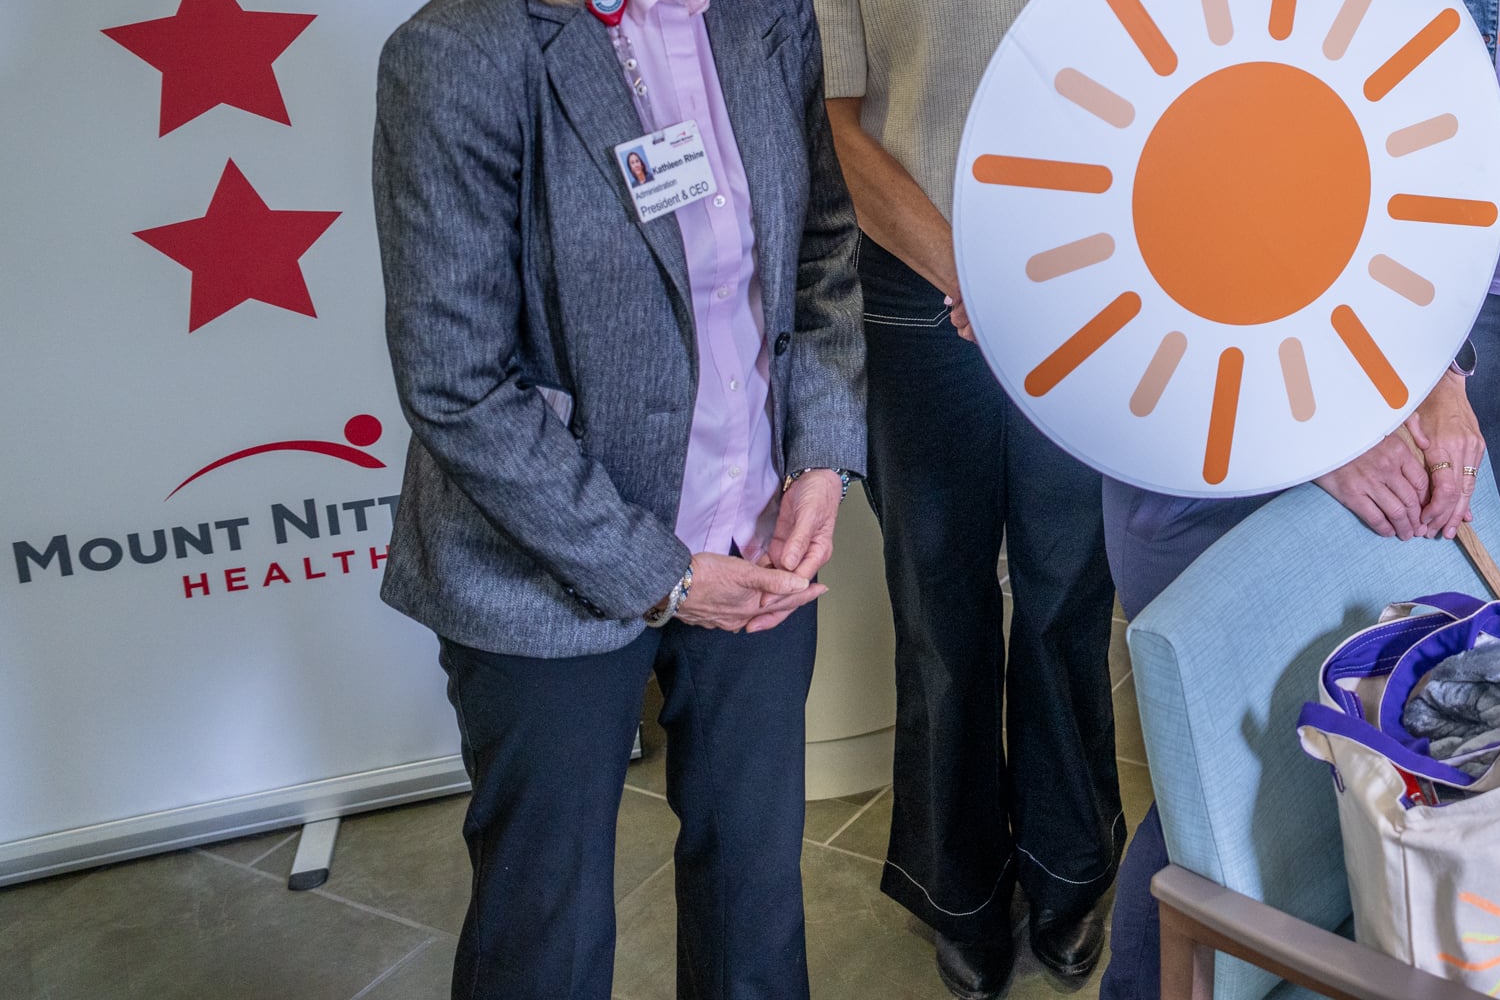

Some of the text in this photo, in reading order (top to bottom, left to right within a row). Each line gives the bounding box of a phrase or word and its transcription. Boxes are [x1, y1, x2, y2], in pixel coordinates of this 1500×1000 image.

[652, 158, 684, 175] Kathleen
[640, 180, 710, 217] President & CEO
[271, 494, 402, 545] NITT
[12, 517, 250, 584] MOUNT
[182, 544, 392, 599] HEALTH
